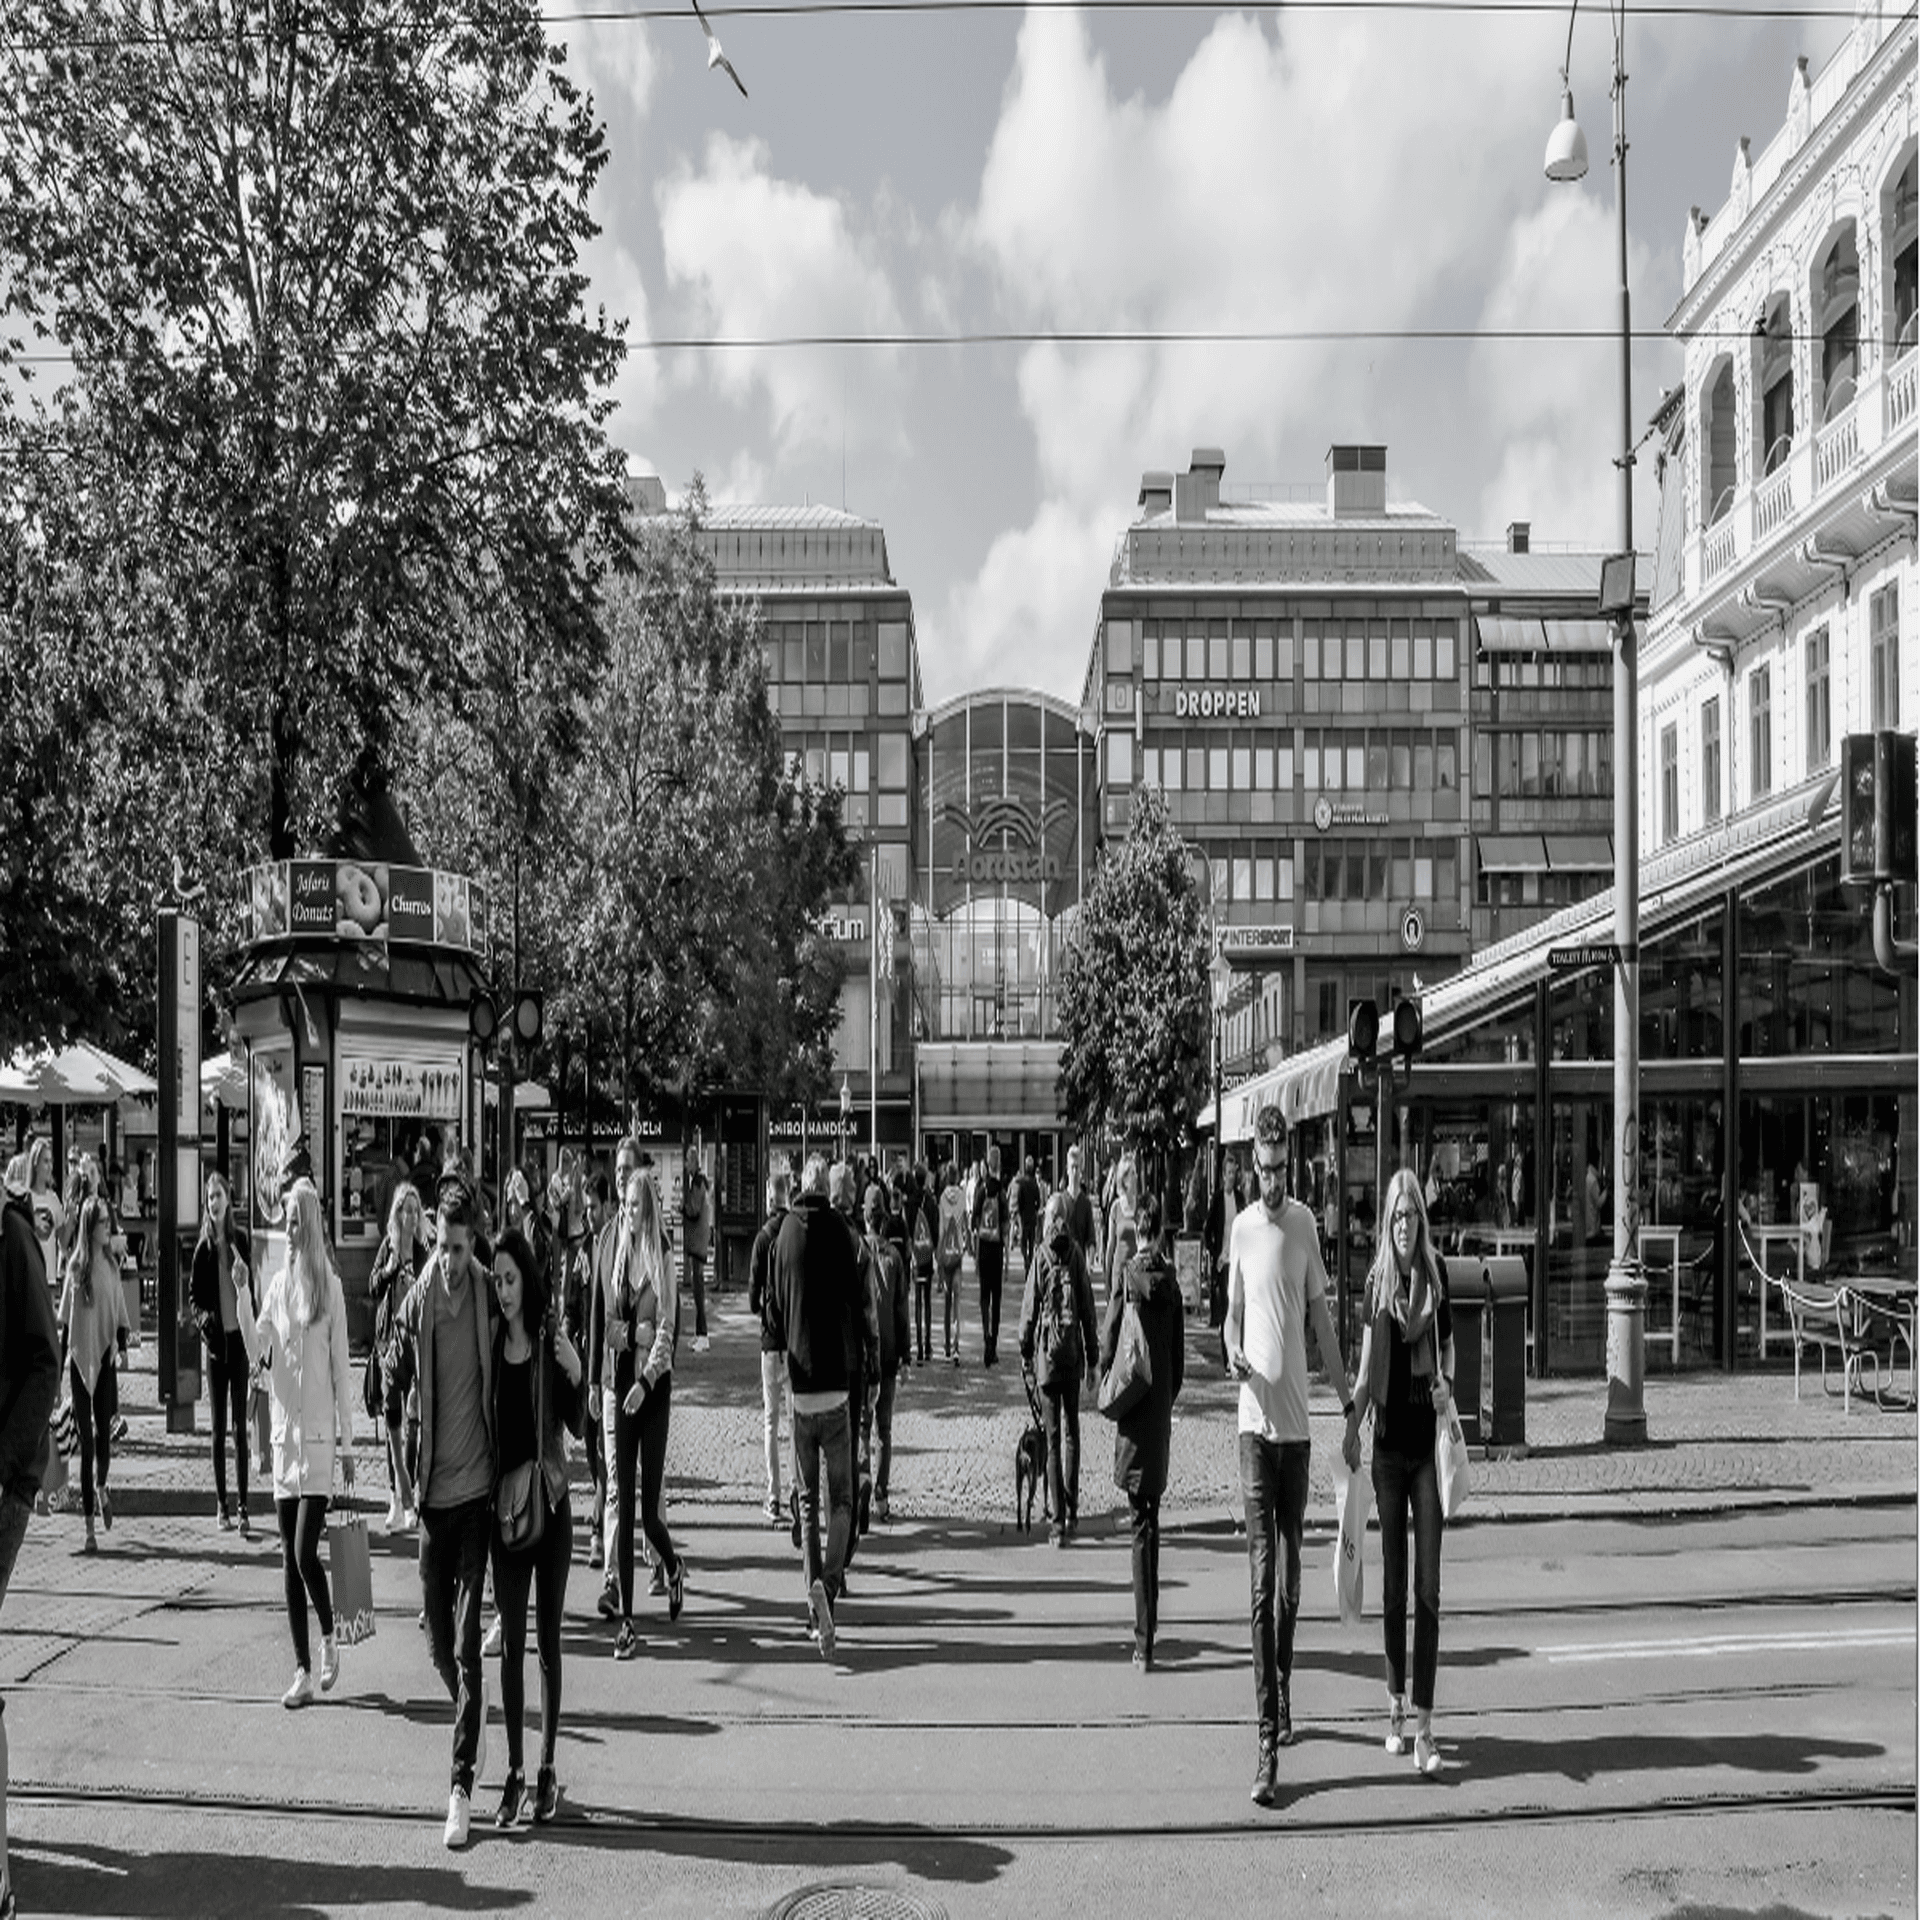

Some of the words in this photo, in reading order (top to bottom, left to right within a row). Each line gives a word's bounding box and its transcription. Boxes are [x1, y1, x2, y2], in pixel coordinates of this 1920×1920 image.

[1176, 690, 1260, 716] DROPPEN
[293, 901, 333, 922] Donuts
[391, 893, 432, 915] Churros
[1229, 929, 1292, 946] INTERSPORT
